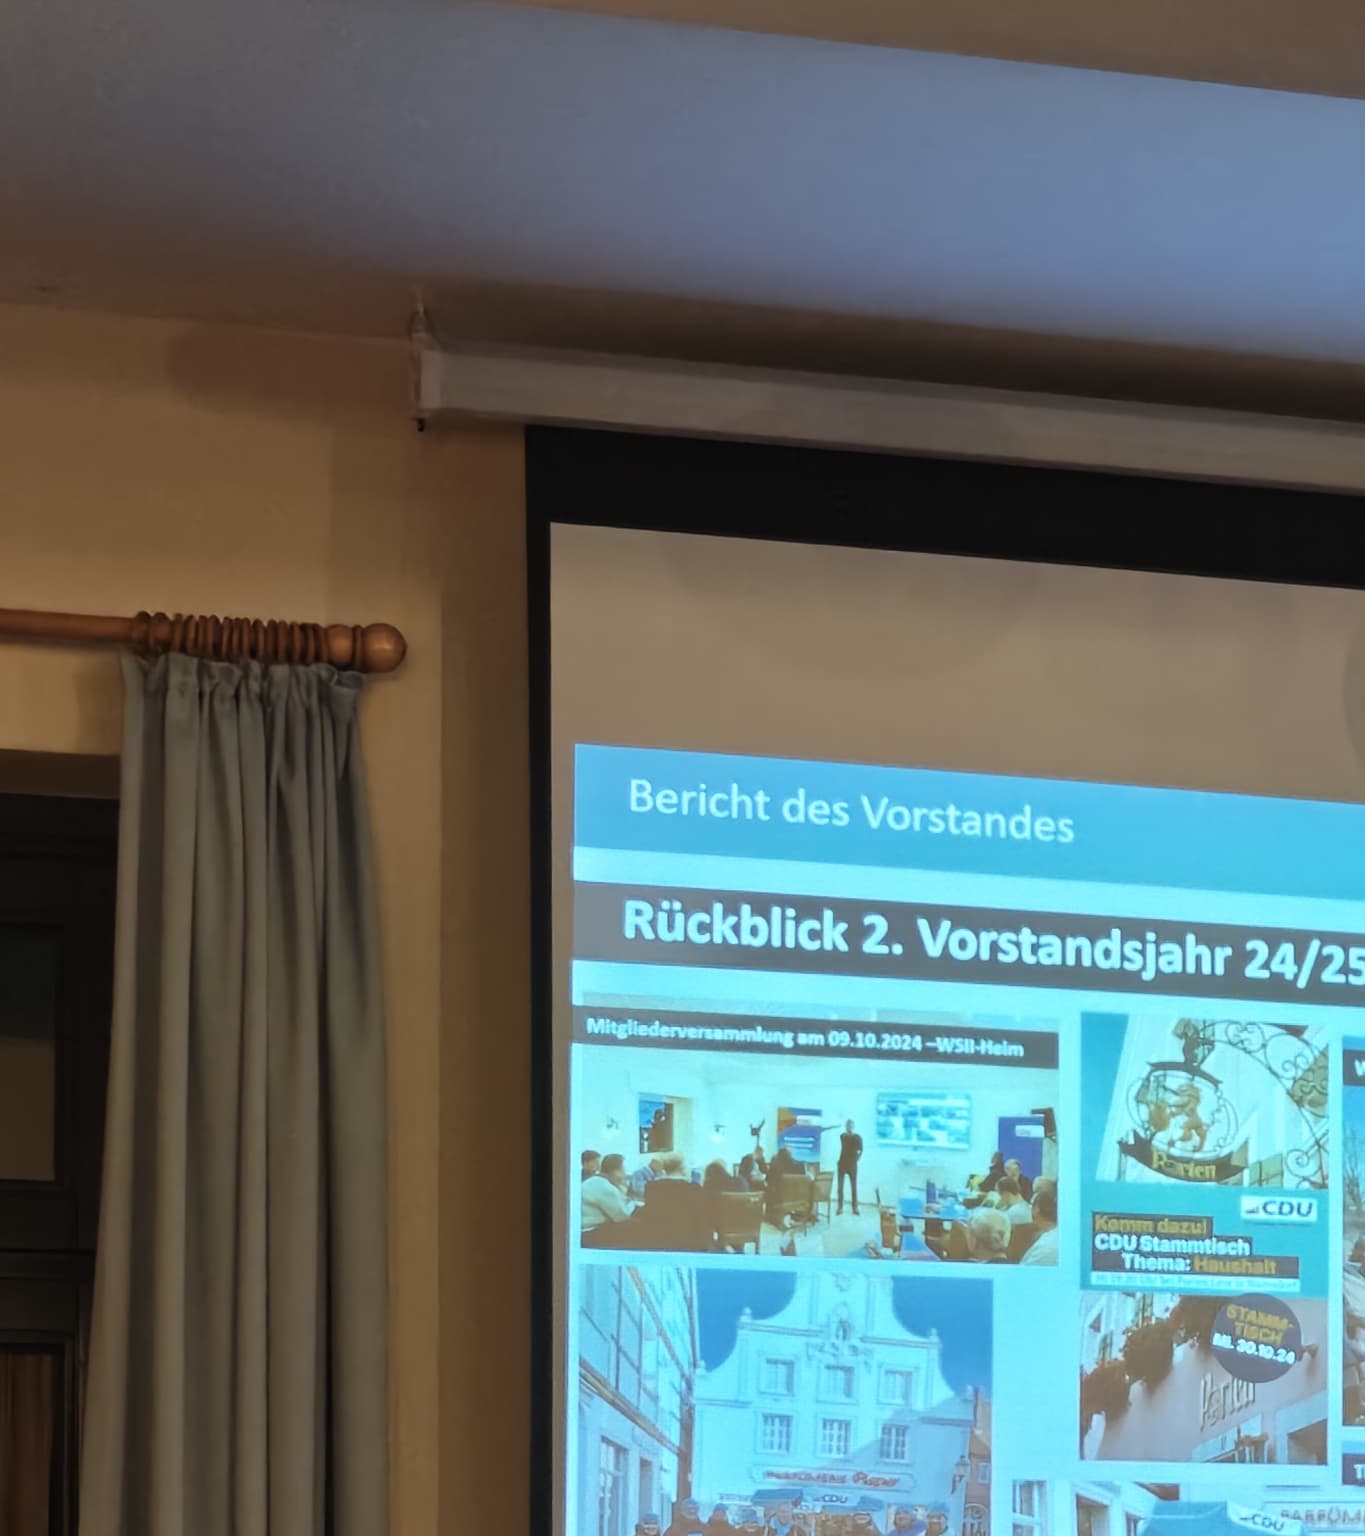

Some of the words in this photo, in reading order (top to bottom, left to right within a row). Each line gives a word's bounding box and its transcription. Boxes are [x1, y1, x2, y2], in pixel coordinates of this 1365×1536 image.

[629, 778, 770, 822] Bericht
[782, 787, 849, 826] des
[860, 794, 1075, 844] Vorstandes
[623, 900, 849, 953] Rückblick
[862, 917, 904, 956] 2.
[917, 917, 1233, 982] Vorstandsjahr
[587, 1016, 794, 1049] Mitgliederversammlung
[797, 1032, 825, 1048] am
[827, 1028, 923, 1053] 09.10.2024
[1262, 1199, 1313, 1218] CDU
[1094, 1214, 1154, 1231] Komm
[1157, 1217, 1208, 1235] dazu!
[1093, 1233, 1137, 1252] CDU
[1139, 1235, 1251, 1256] Stammtisch
[1121, 1252, 1191, 1272] Thema:
[1194, 1256, 1277, 1276] Haushalt
